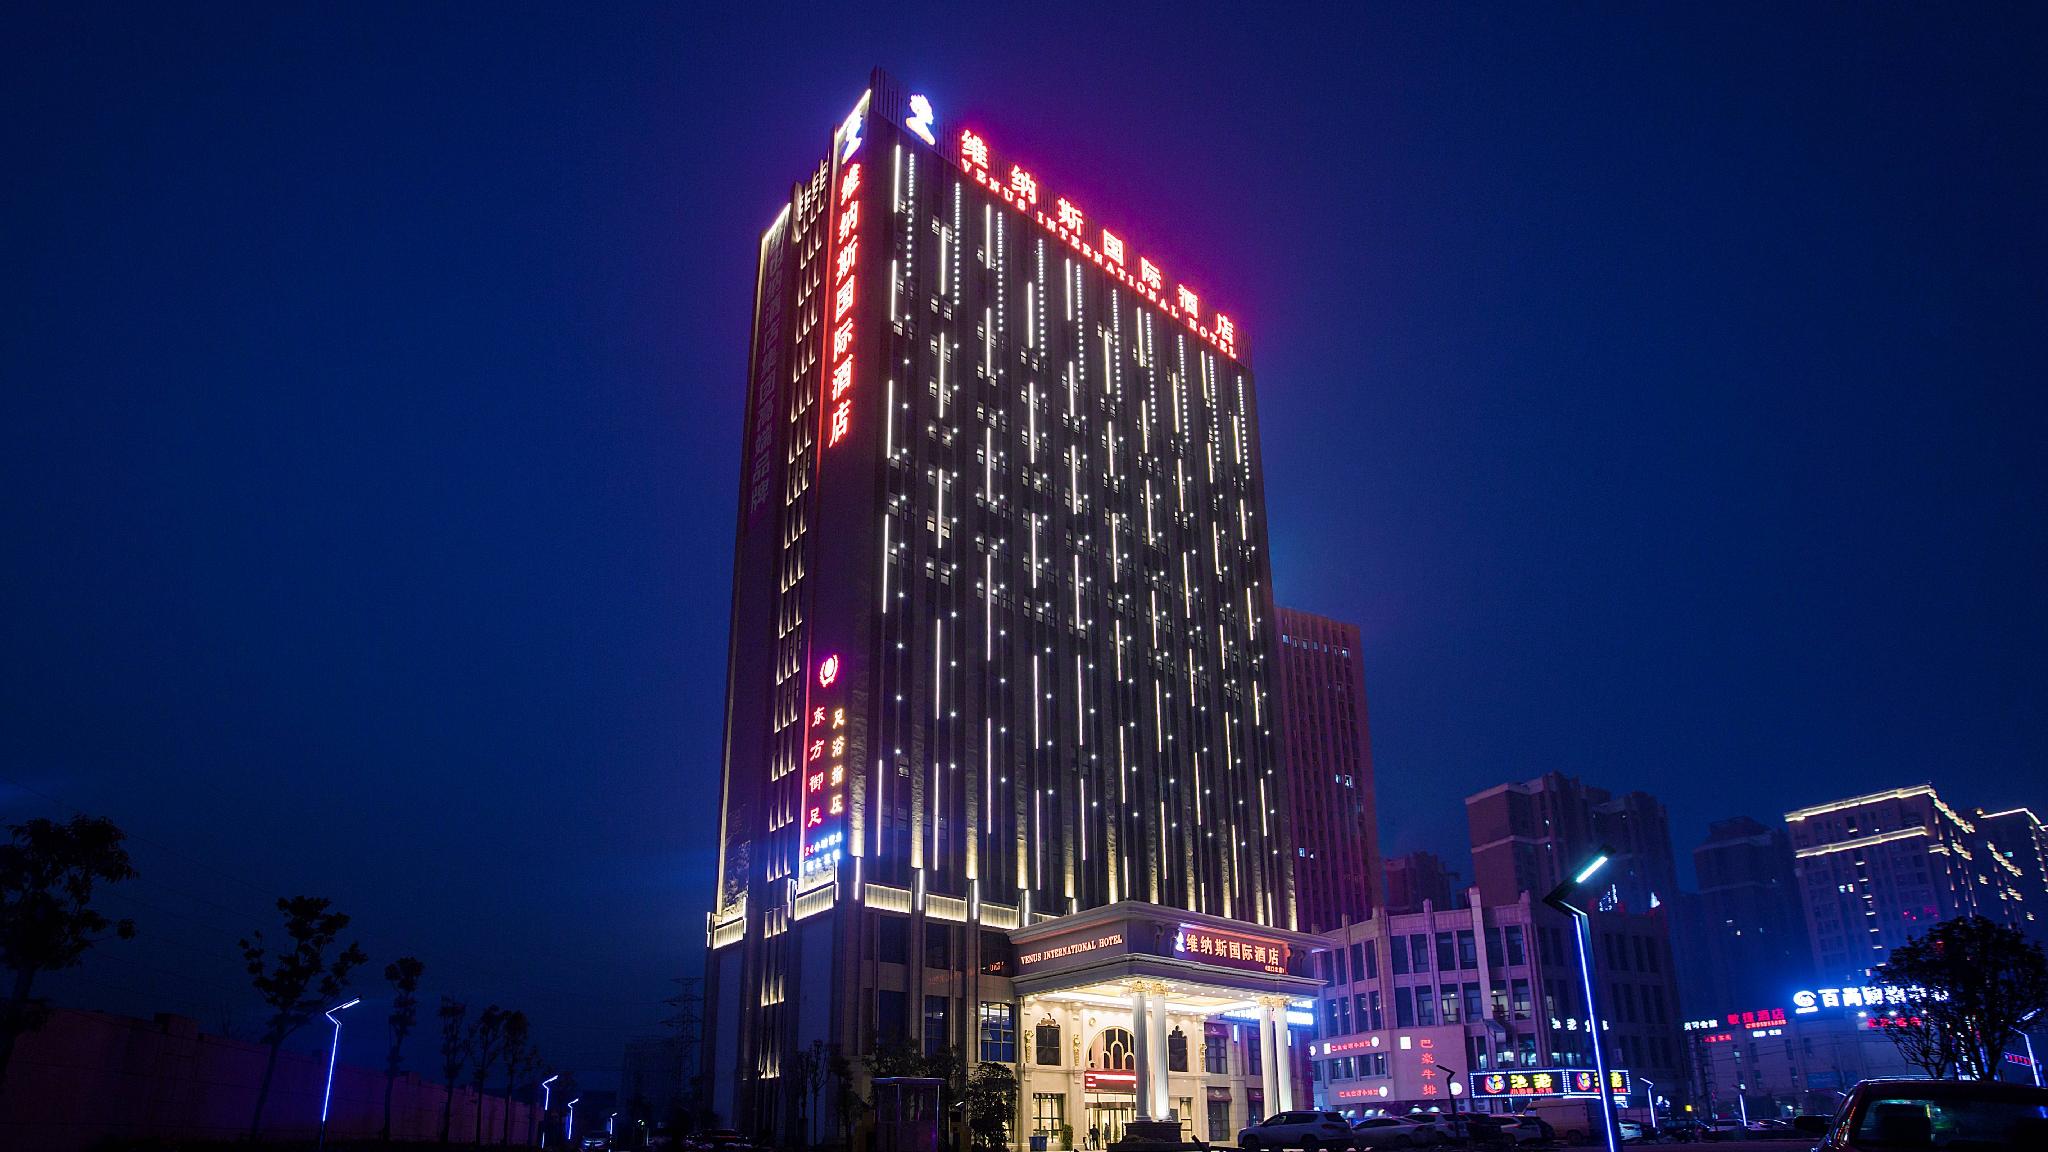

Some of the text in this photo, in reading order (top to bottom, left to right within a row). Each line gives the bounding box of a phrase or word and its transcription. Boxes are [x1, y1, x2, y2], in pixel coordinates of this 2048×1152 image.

[829, 163, 861, 448] 维纳斯国际酒店
[961, 129, 1235, 346] 维纳斯国际酒店
[961, 158, 1237, 359] VENUS INTERNATIONAL HOTEL
[751, 233, 786, 514] 也纳酒店集团高端品牌
[808, 706, 826, 827] 东方御足
[1020, 934, 1123, 965] VENUS INTERNATIONAL HOTEL
[1185, 933, 1279, 966] 维纳斯国际酒店
